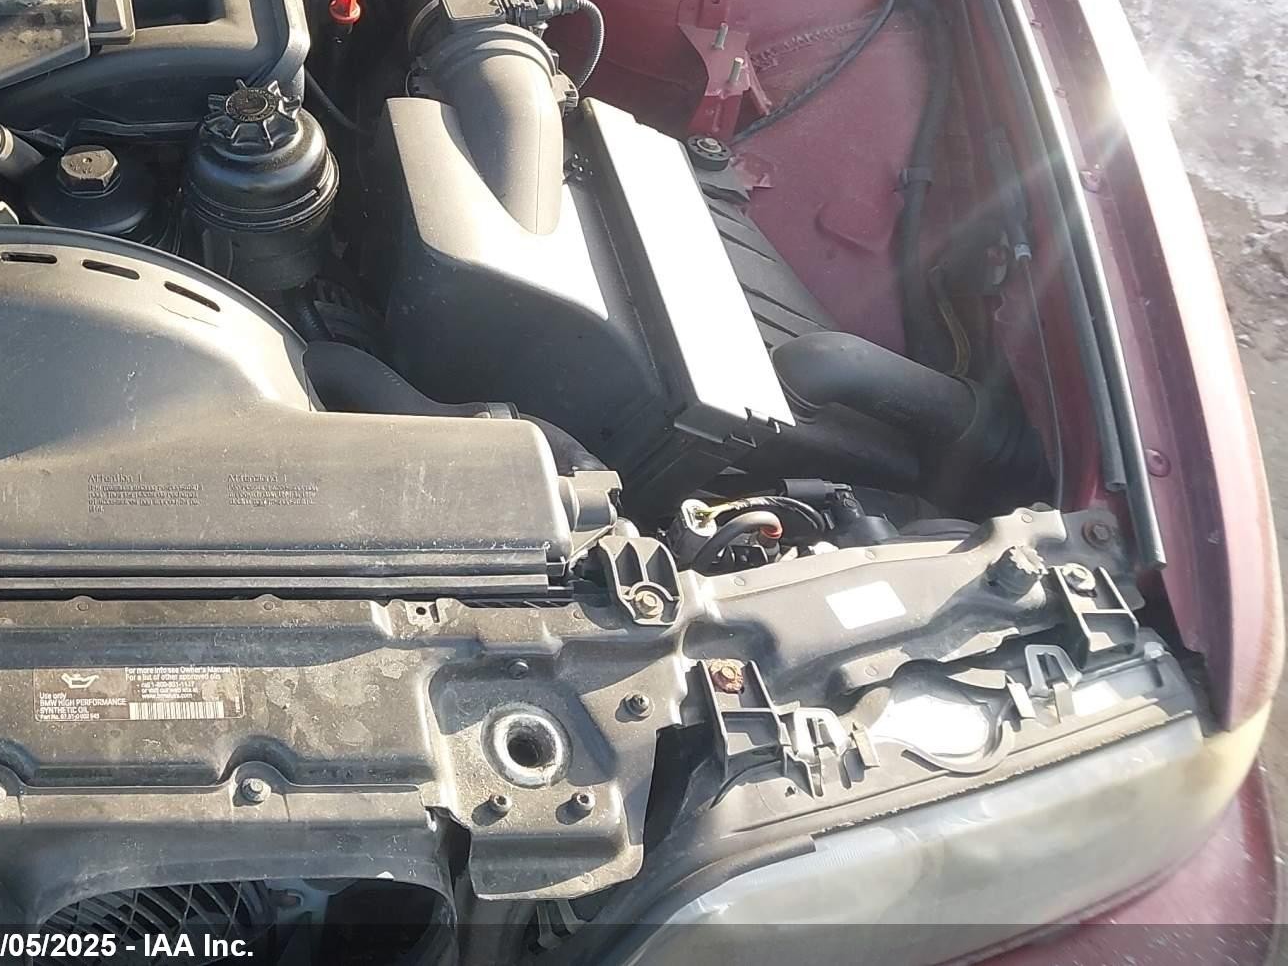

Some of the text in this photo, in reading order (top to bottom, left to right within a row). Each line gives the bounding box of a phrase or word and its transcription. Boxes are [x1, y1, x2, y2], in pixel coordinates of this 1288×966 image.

[39, 692, 67, 702] Use only
[40, 698, 127, 707] BMW HIGH PERFORMANCE
[78, 706, 89, 714] OIL
